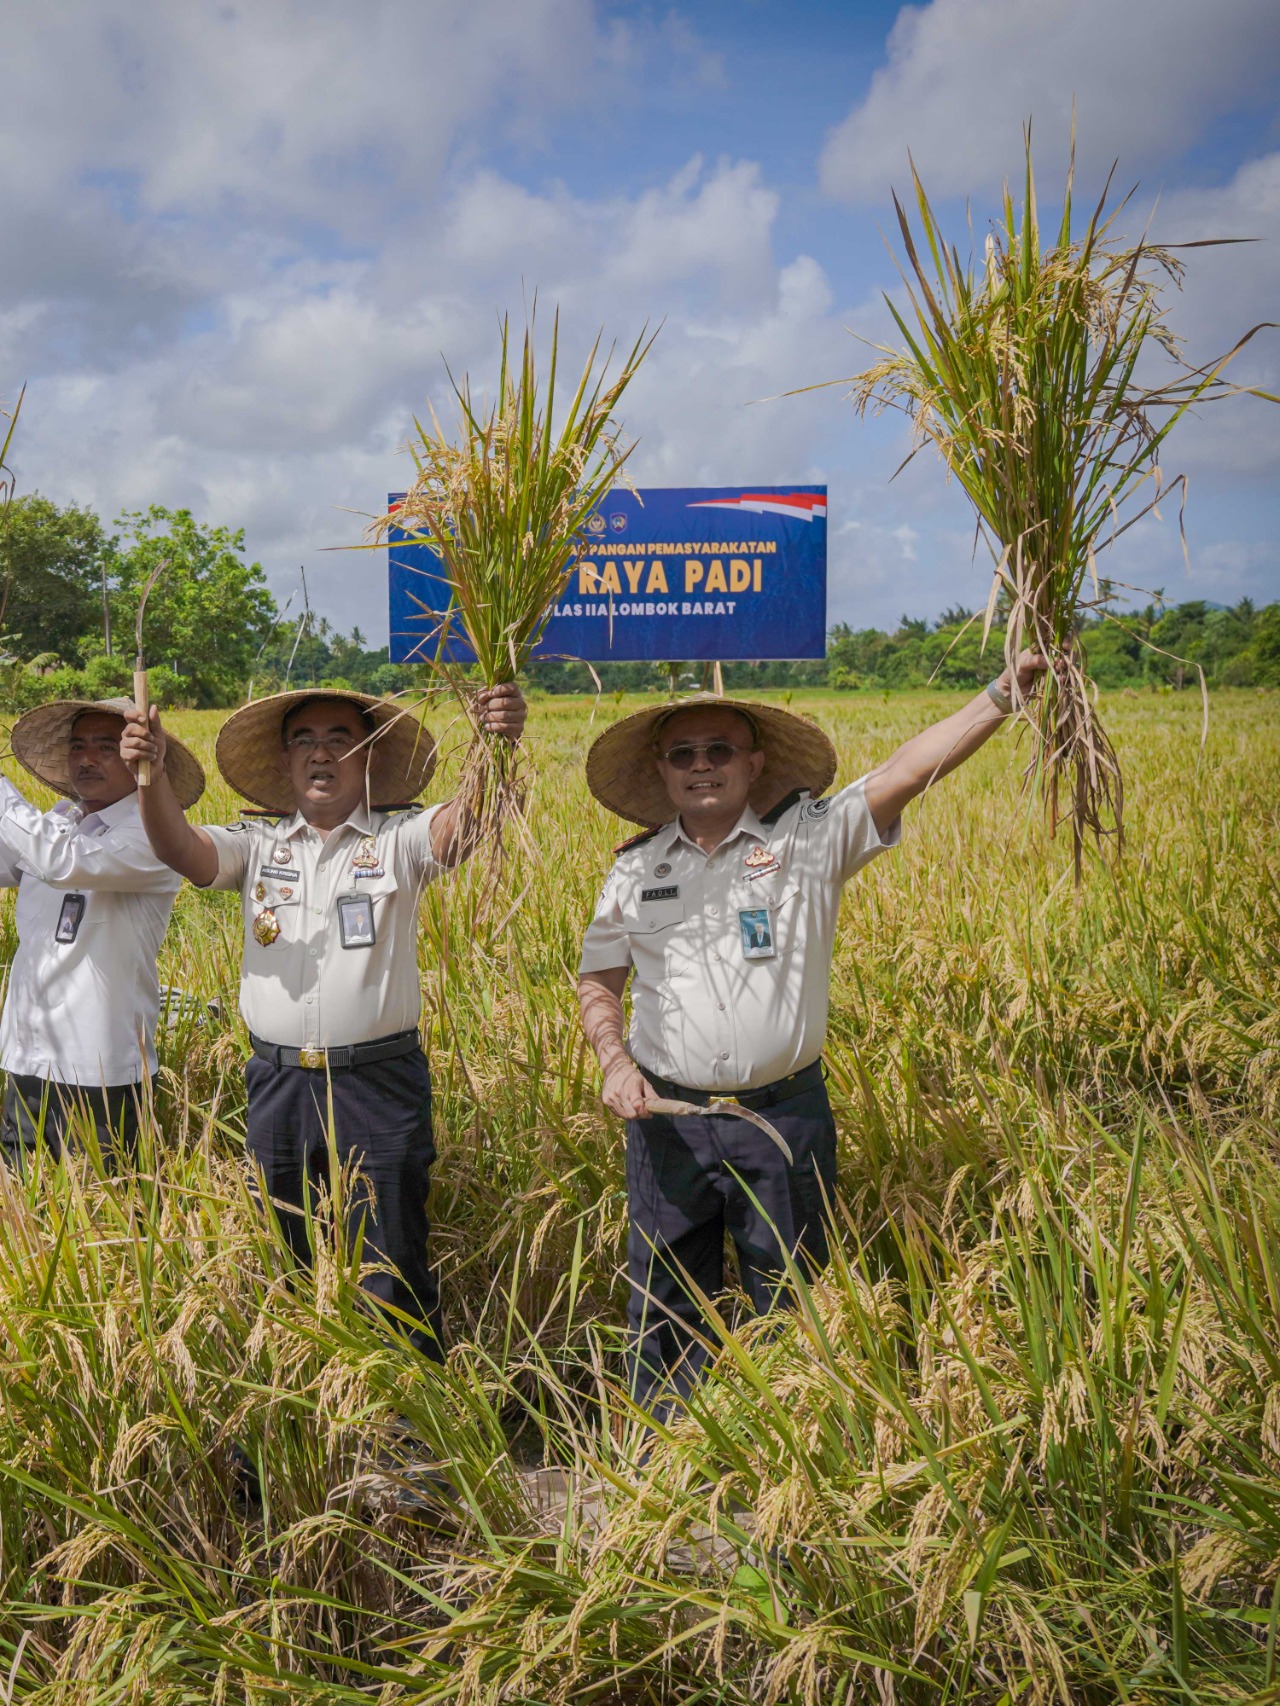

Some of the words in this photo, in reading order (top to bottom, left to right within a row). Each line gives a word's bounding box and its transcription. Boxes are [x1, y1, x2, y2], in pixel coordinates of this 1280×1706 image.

[589, 543, 646, 556] PANGAN
[648, 541, 777, 555] PEMASYARAKATAN
[579, 560, 669, 595] RAYA
[684, 559, 762, 593] PADI
[585, 604, 609, 616] IIA
[609, 602, 679, 616] LOMBOK
[682, 601, 737, 615] BARAT
